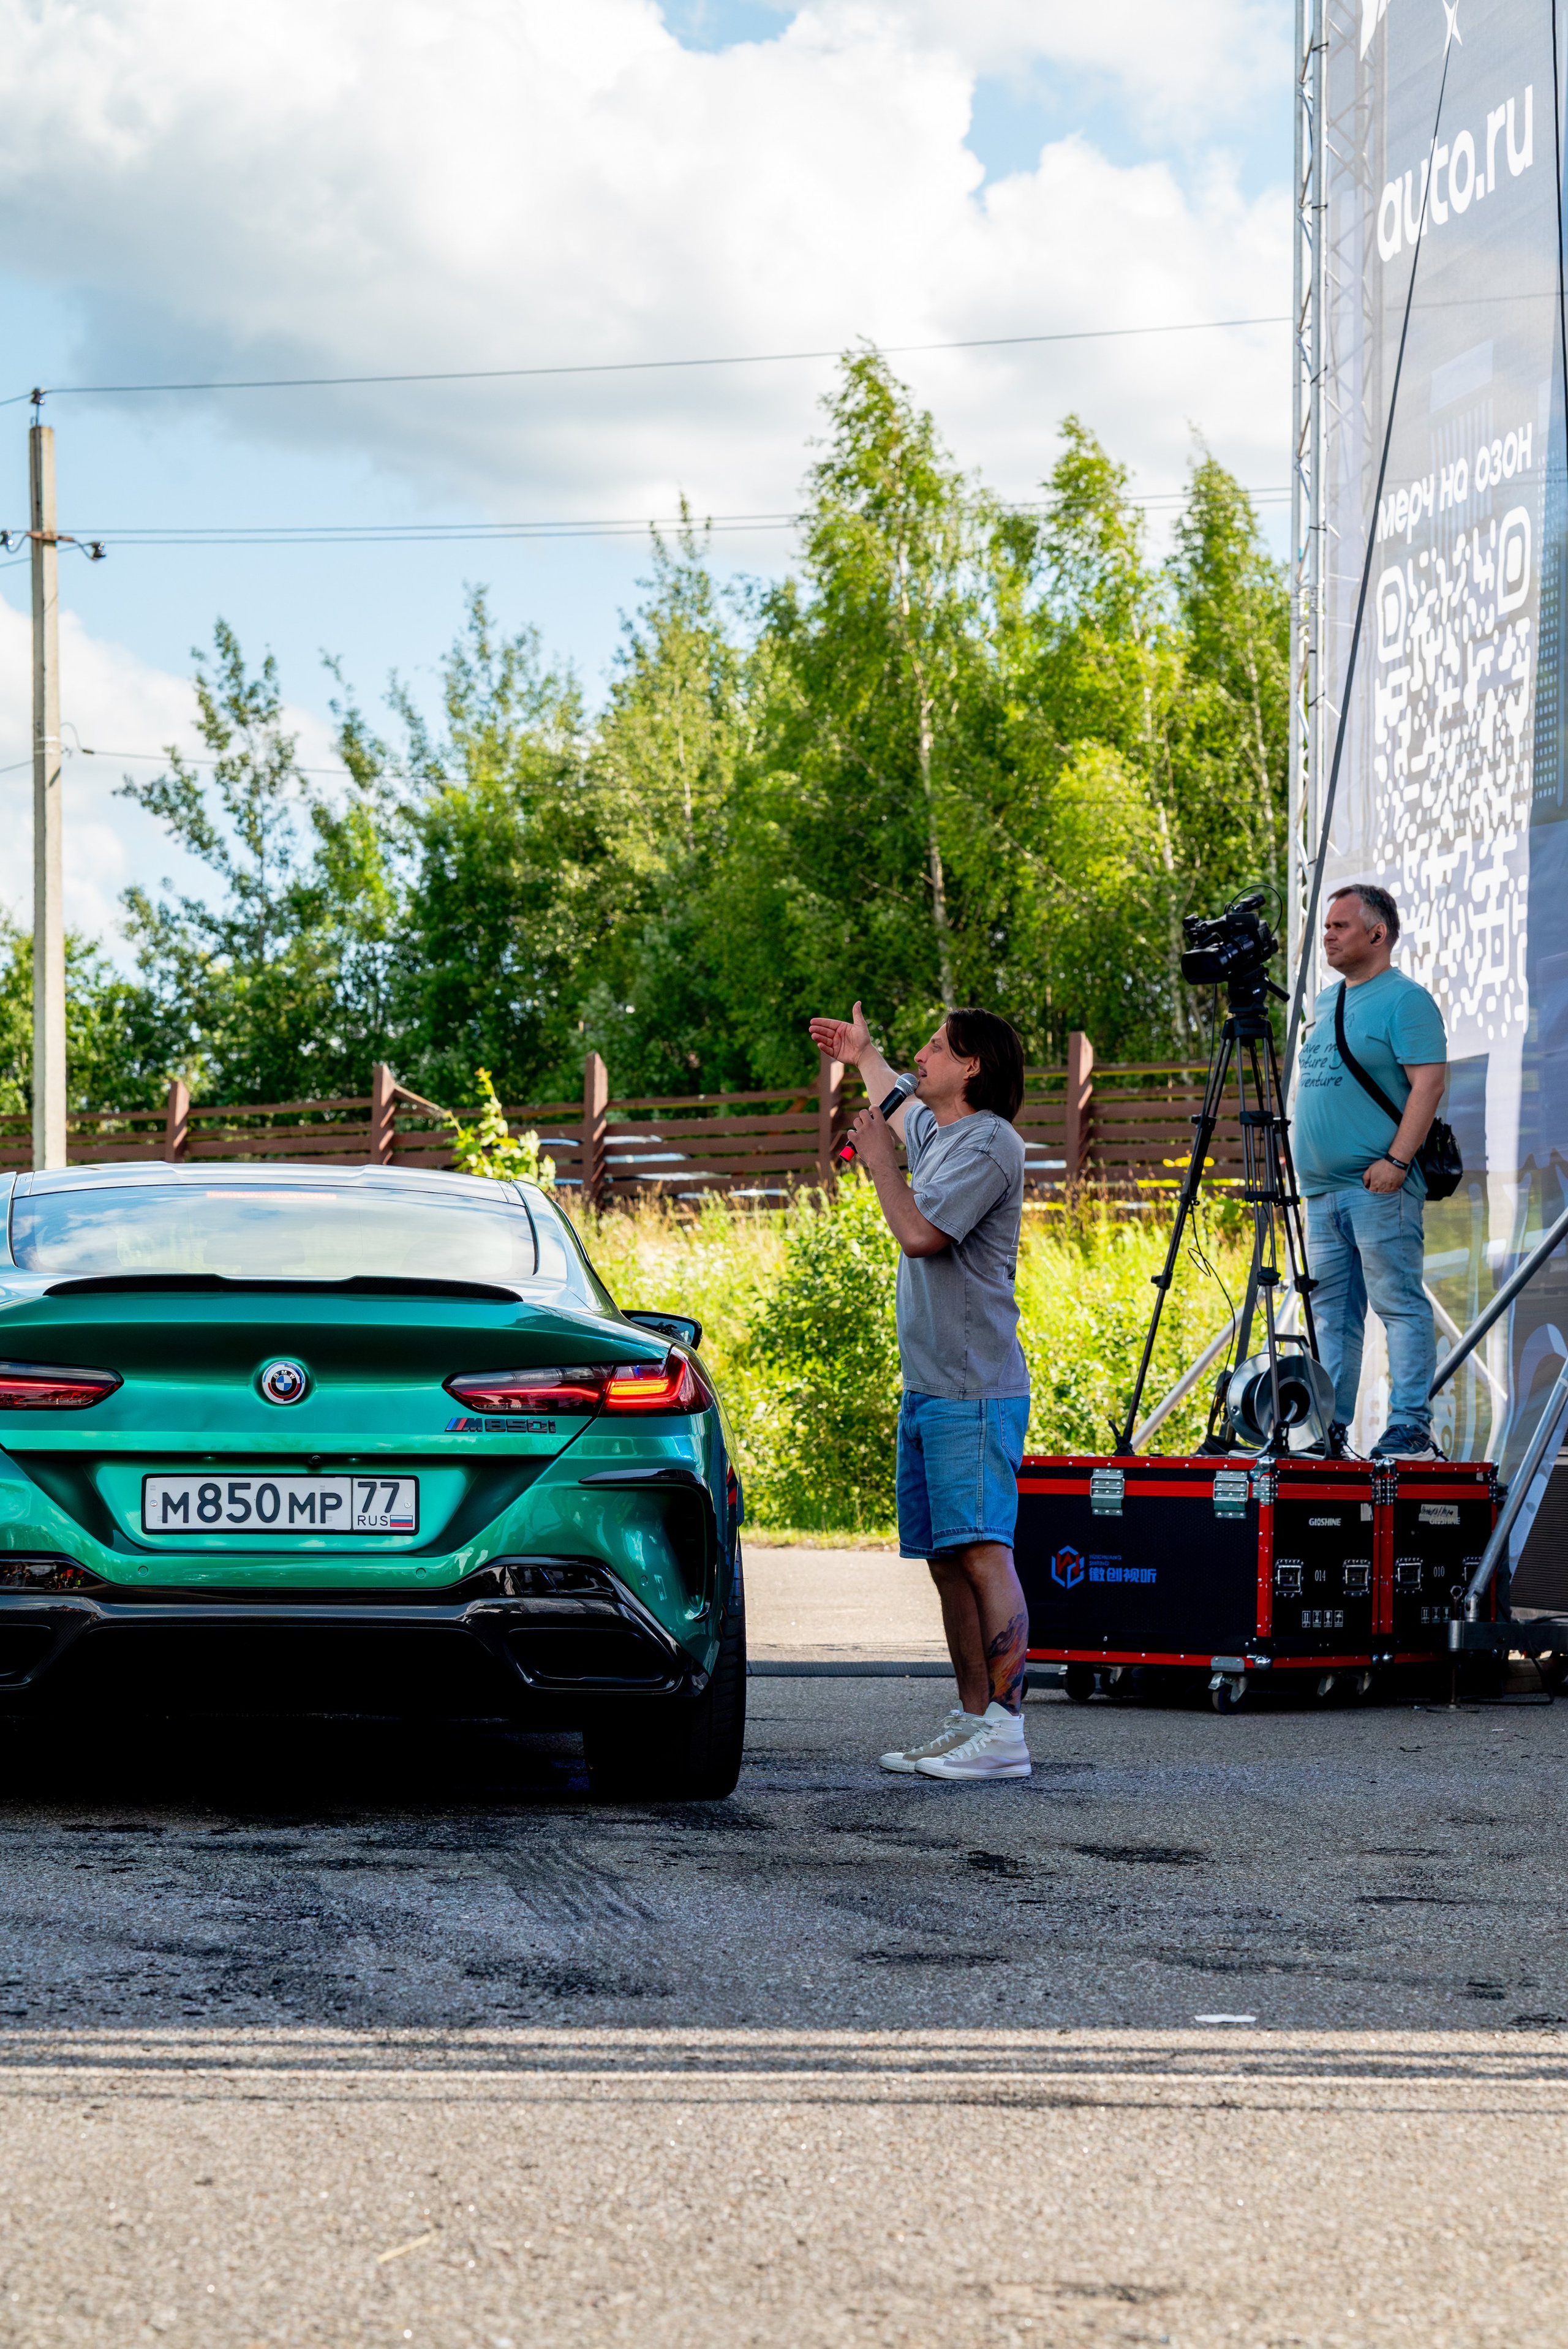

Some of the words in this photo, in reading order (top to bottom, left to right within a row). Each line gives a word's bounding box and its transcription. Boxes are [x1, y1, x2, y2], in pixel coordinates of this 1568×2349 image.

[1377, 84, 1533, 262] auto.ru
[1302, 1043, 1321, 1054] ave
[273, 1370, 295, 1379] BMW
[357, 1481, 401, 1514] 77
[357, 1515, 389, 1526] RUS
[1314, 1569, 1326, 1582] 014
[1433, 1566, 1446, 1577] 010
